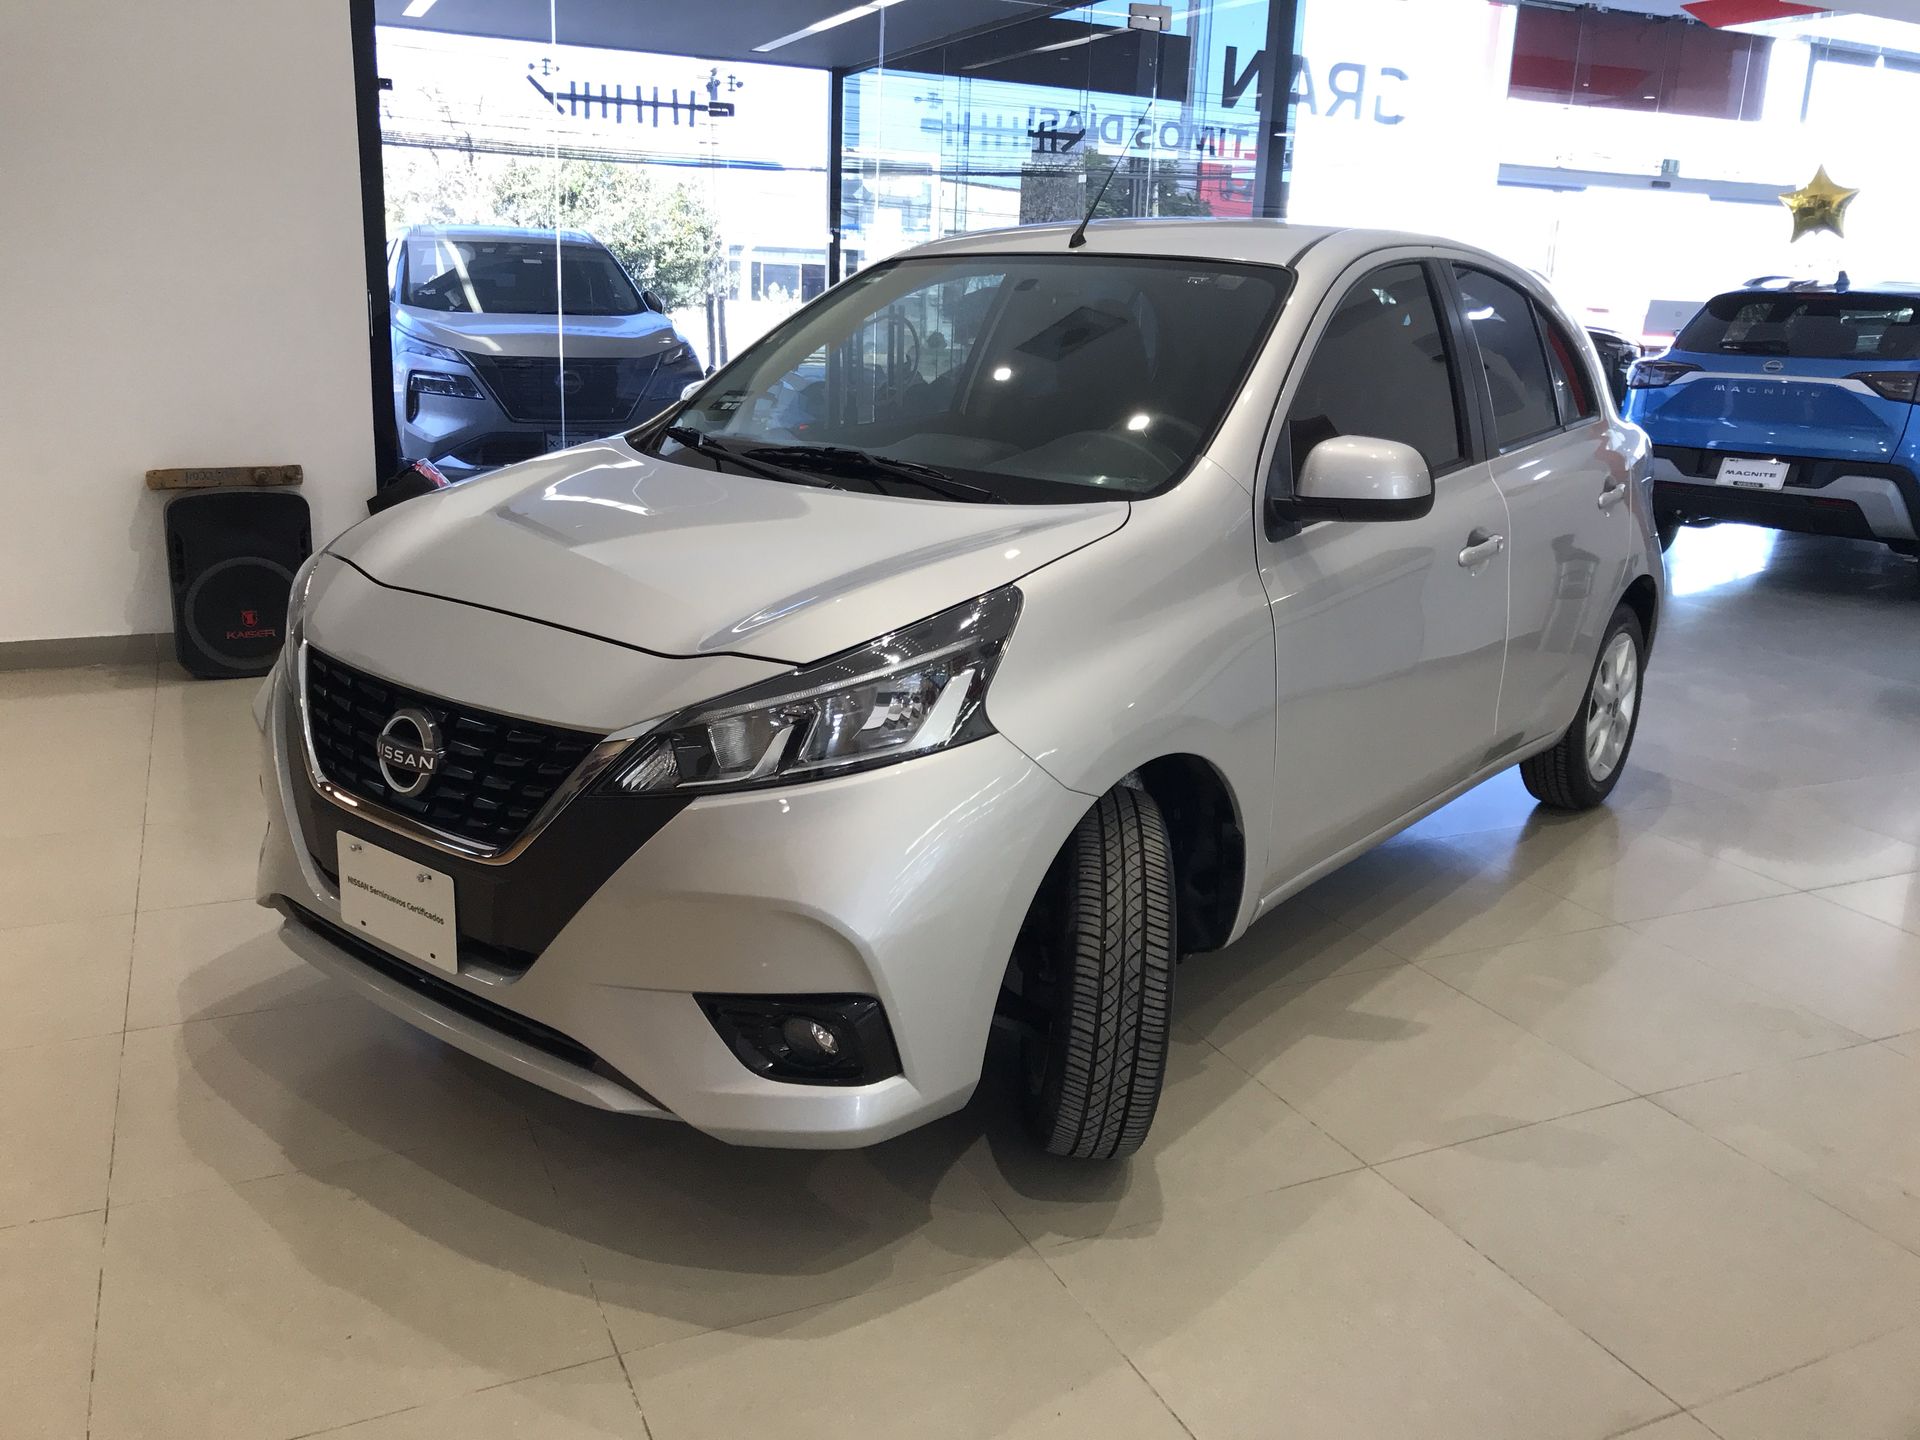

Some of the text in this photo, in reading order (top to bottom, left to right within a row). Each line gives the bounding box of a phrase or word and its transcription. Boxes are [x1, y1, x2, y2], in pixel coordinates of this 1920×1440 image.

[1713, 384, 1822, 398] MAGNITE
[1725, 469, 1777, 479] MAGNITE
[226, 629, 276, 640] KAISER
[347, 875, 445, 925] NISSAN Seminuevos Certificados
